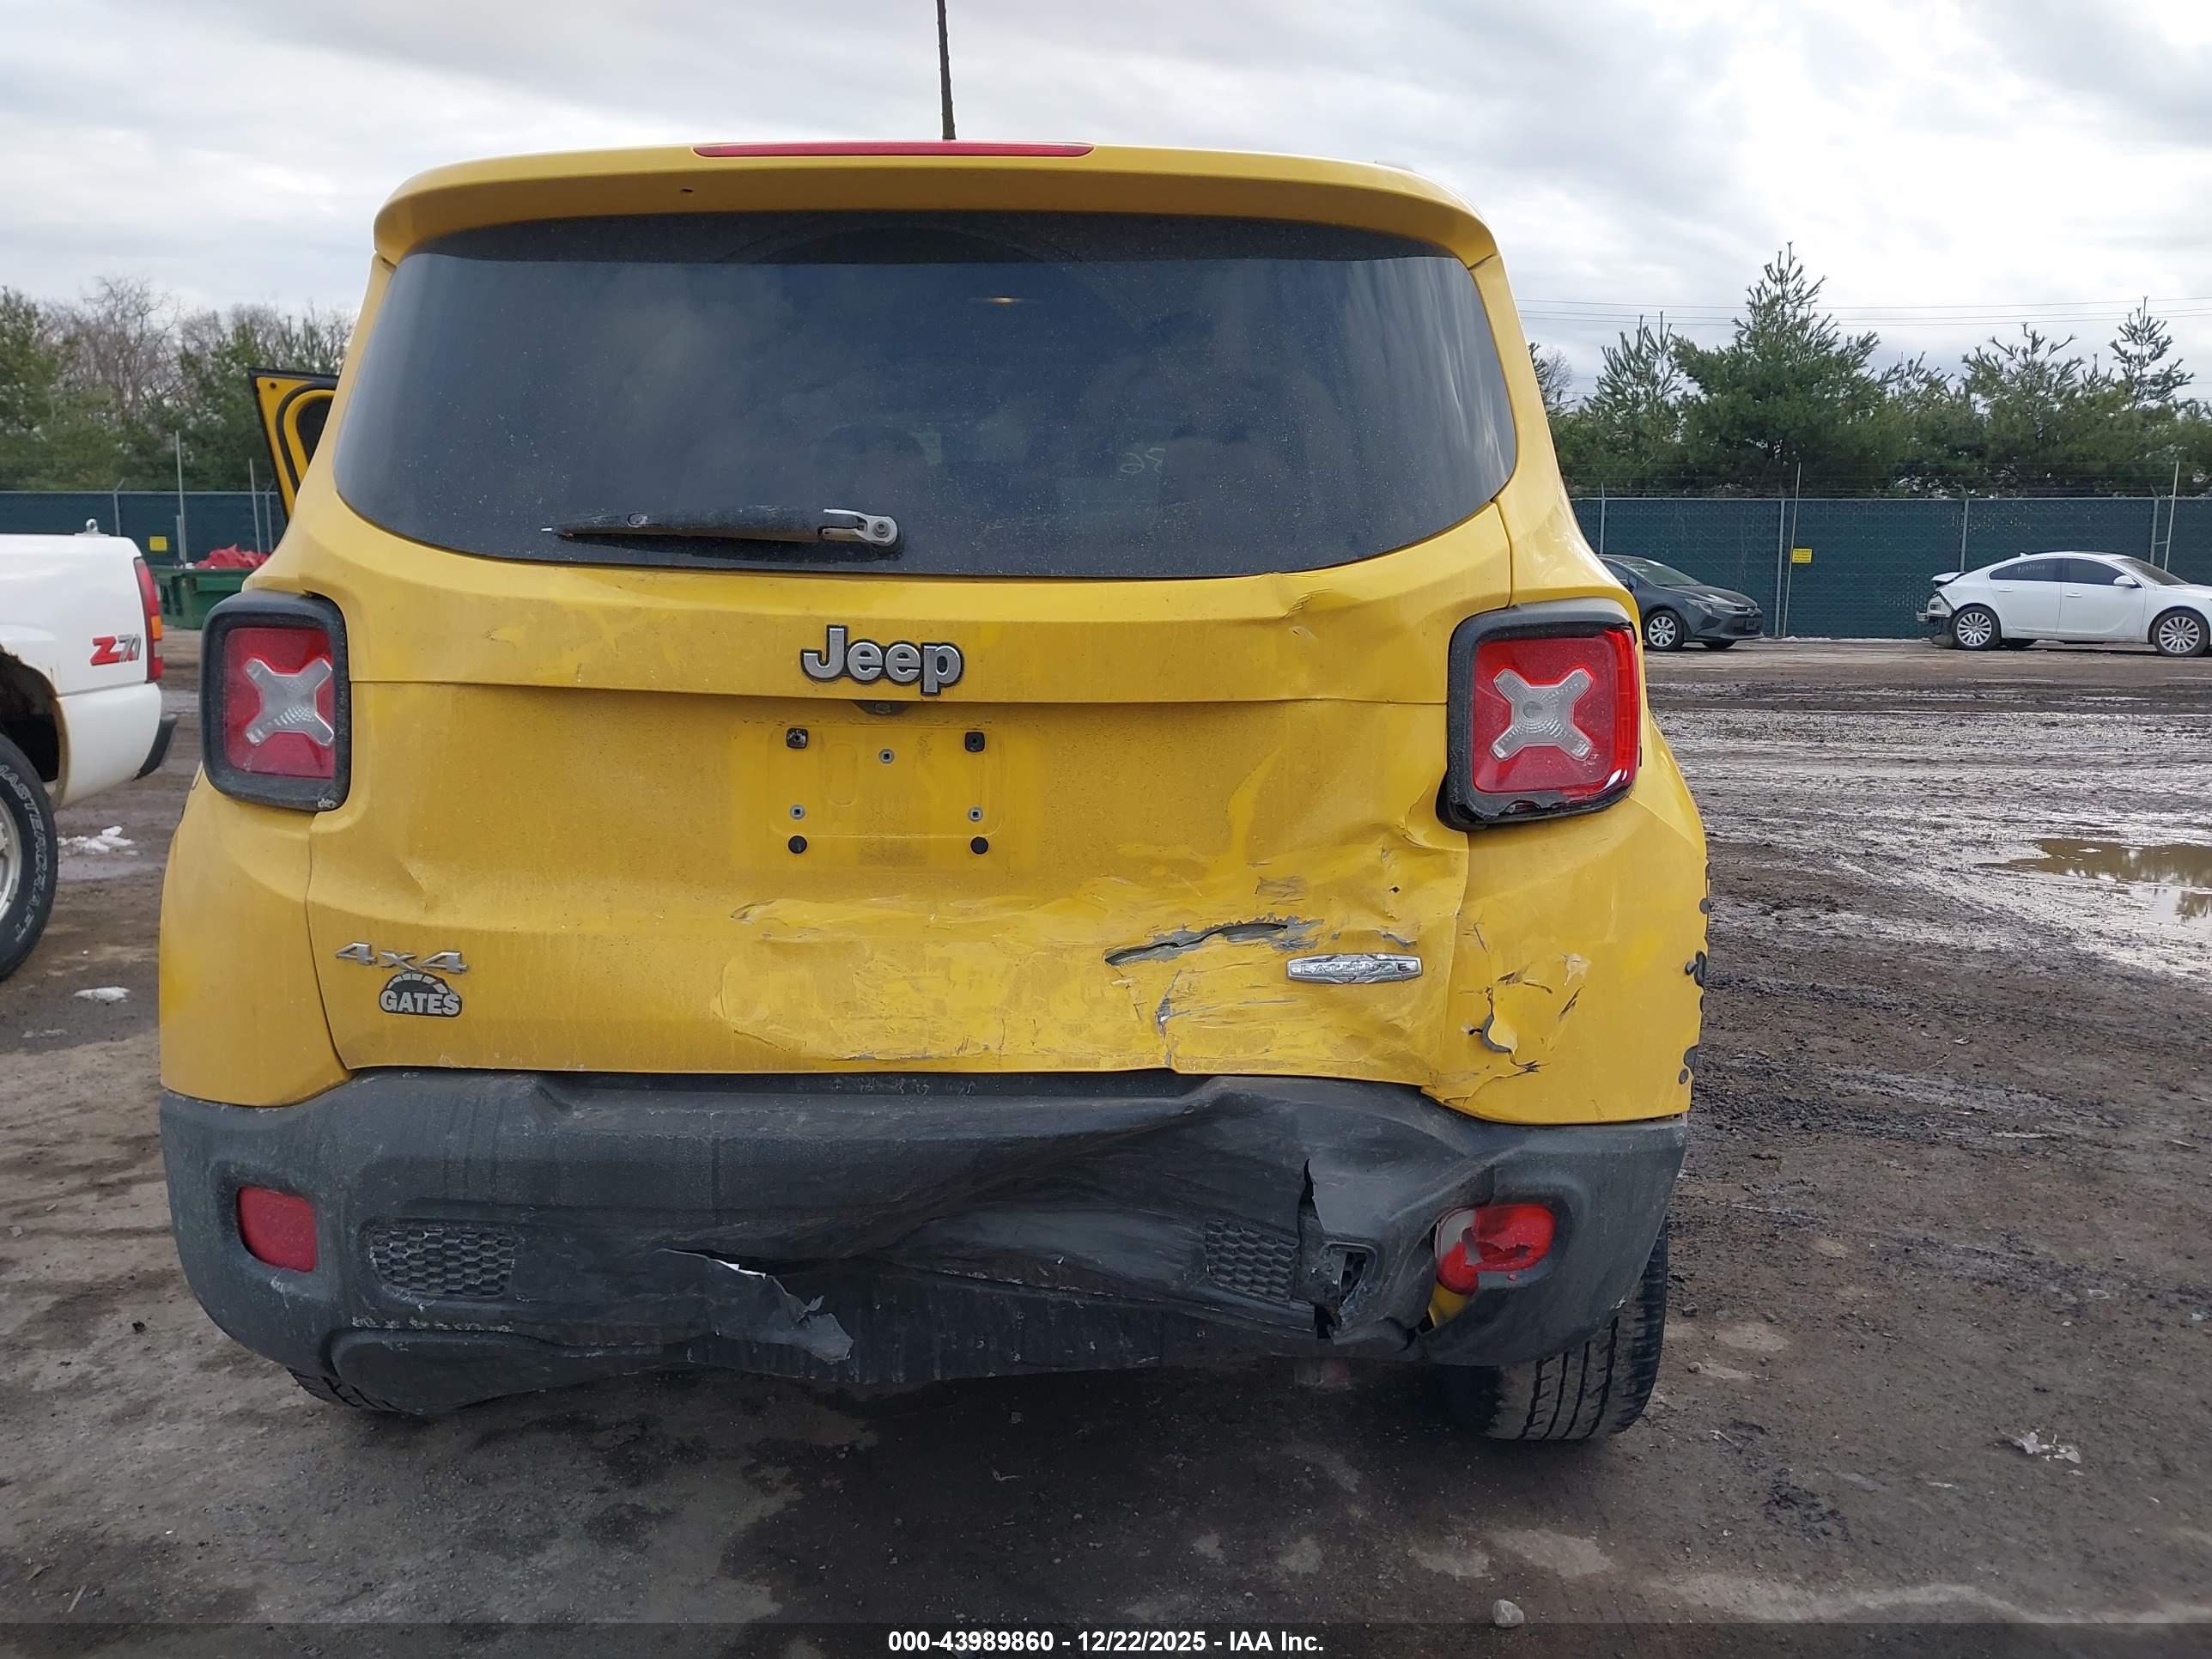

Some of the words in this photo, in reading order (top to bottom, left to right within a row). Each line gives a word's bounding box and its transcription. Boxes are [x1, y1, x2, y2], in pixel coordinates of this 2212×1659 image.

[89, 634, 142, 666] Z71
[800, 624, 963, 696] Jeep
[335, 941, 468, 974] 4x4
[380, 989, 461, 1017] GATES
